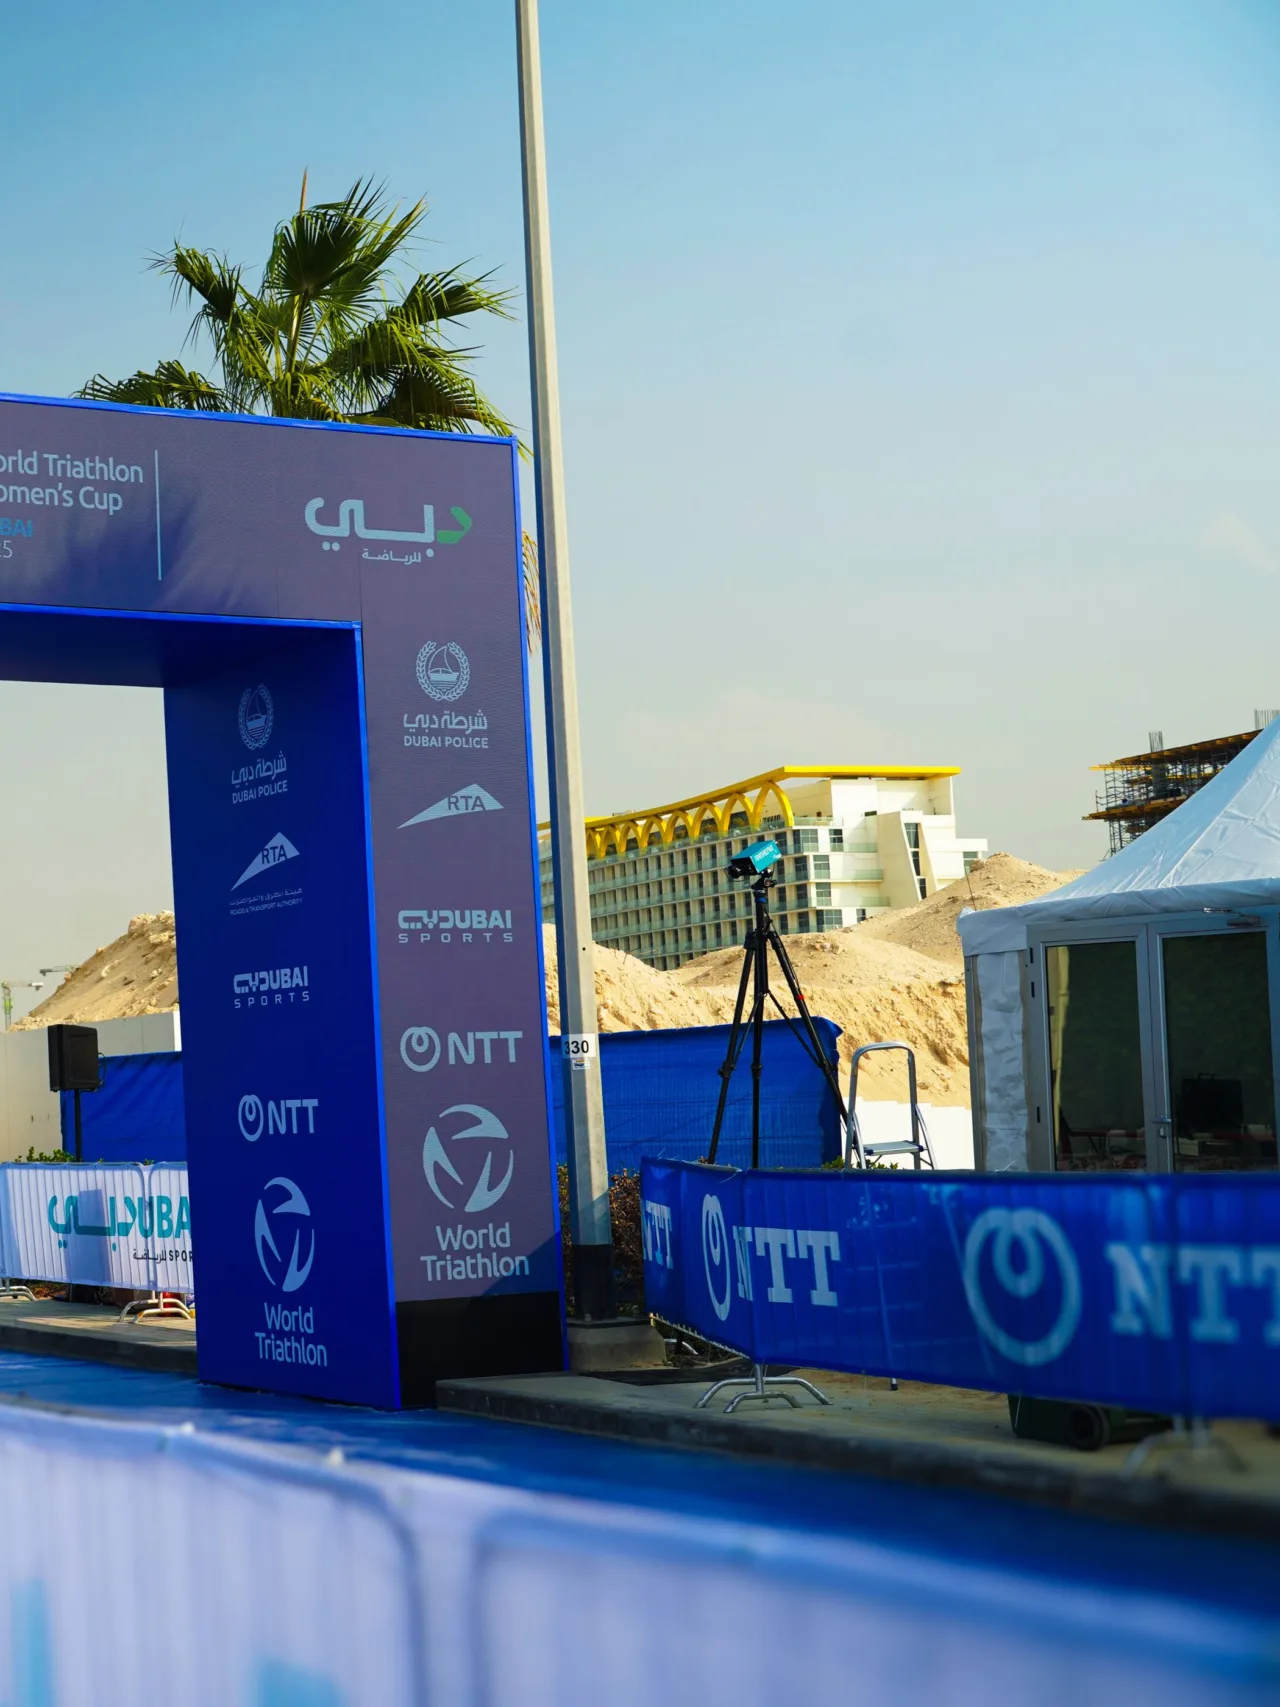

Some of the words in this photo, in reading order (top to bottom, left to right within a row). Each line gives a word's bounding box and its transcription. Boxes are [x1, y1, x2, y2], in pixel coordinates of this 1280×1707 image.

[43, 453, 144, 483] Triathlon
[78, 486, 123, 515] Cup
[441, 709, 488, 734] شرطة
[403, 735, 442, 747] DUBAI
[445, 737, 489, 749] POLICE
[232, 786, 257, 804] DUBAI
[258, 780, 288, 797] POLICE
[447, 795, 486, 811] RTA
[261, 844, 288, 865] RTA
[398, 932, 513, 944] SPORTS
[234, 991, 310, 1009] SPORTS
[448, 1030, 523, 1065] NTT
[564, 1040, 589, 1055] 330
[268, 1098, 319, 1135] NTT
[117, 1195, 191, 1239] DUBA
[435, 1221, 511, 1251] World
[420, 1253, 529, 1282] Triathlon
[732, 1225, 841, 1307] NTT
[264, 1302, 314, 1333] World
[255, 1332, 328, 1366] Triathlon
